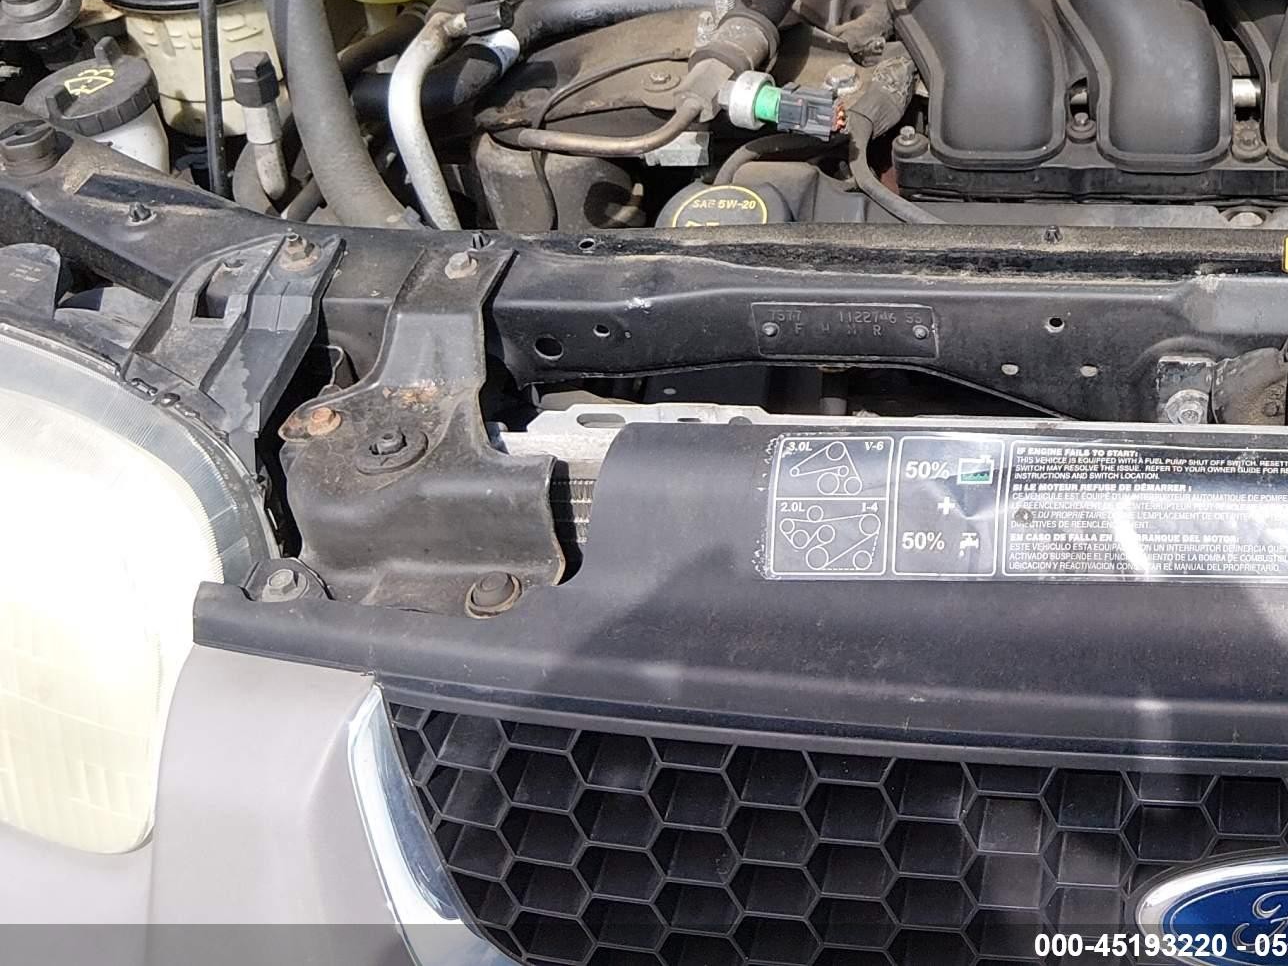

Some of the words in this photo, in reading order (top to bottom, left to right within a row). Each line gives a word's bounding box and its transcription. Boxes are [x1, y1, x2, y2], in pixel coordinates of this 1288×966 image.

[692, 199, 716, 208] SAE
[718, 200, 757, 209] 5W-20
[788, 441, 813, 451] 3.0L
[864, 441, 885, 451] V-6
[1017, 447, 1026, 455] IF
[1028, 448, 1063, 456] ENGINE
[1017, 456, 1034, 464] THIS
[905, 461, 950, 480] 50%
[1248, 494, 1260, 502] DE
[1261, 494, 1288, 502] POMPE
[780, 502, 805, 512] 2.0L
[902, 532, 945, 550] 50%
[1166, 544, 1221, 552] INTERRUPTOR
[1174, 553, 1185, 561] DE
[1163, 562, 1173, 570] EL
[1206, 563, 1221, 571] DEL
